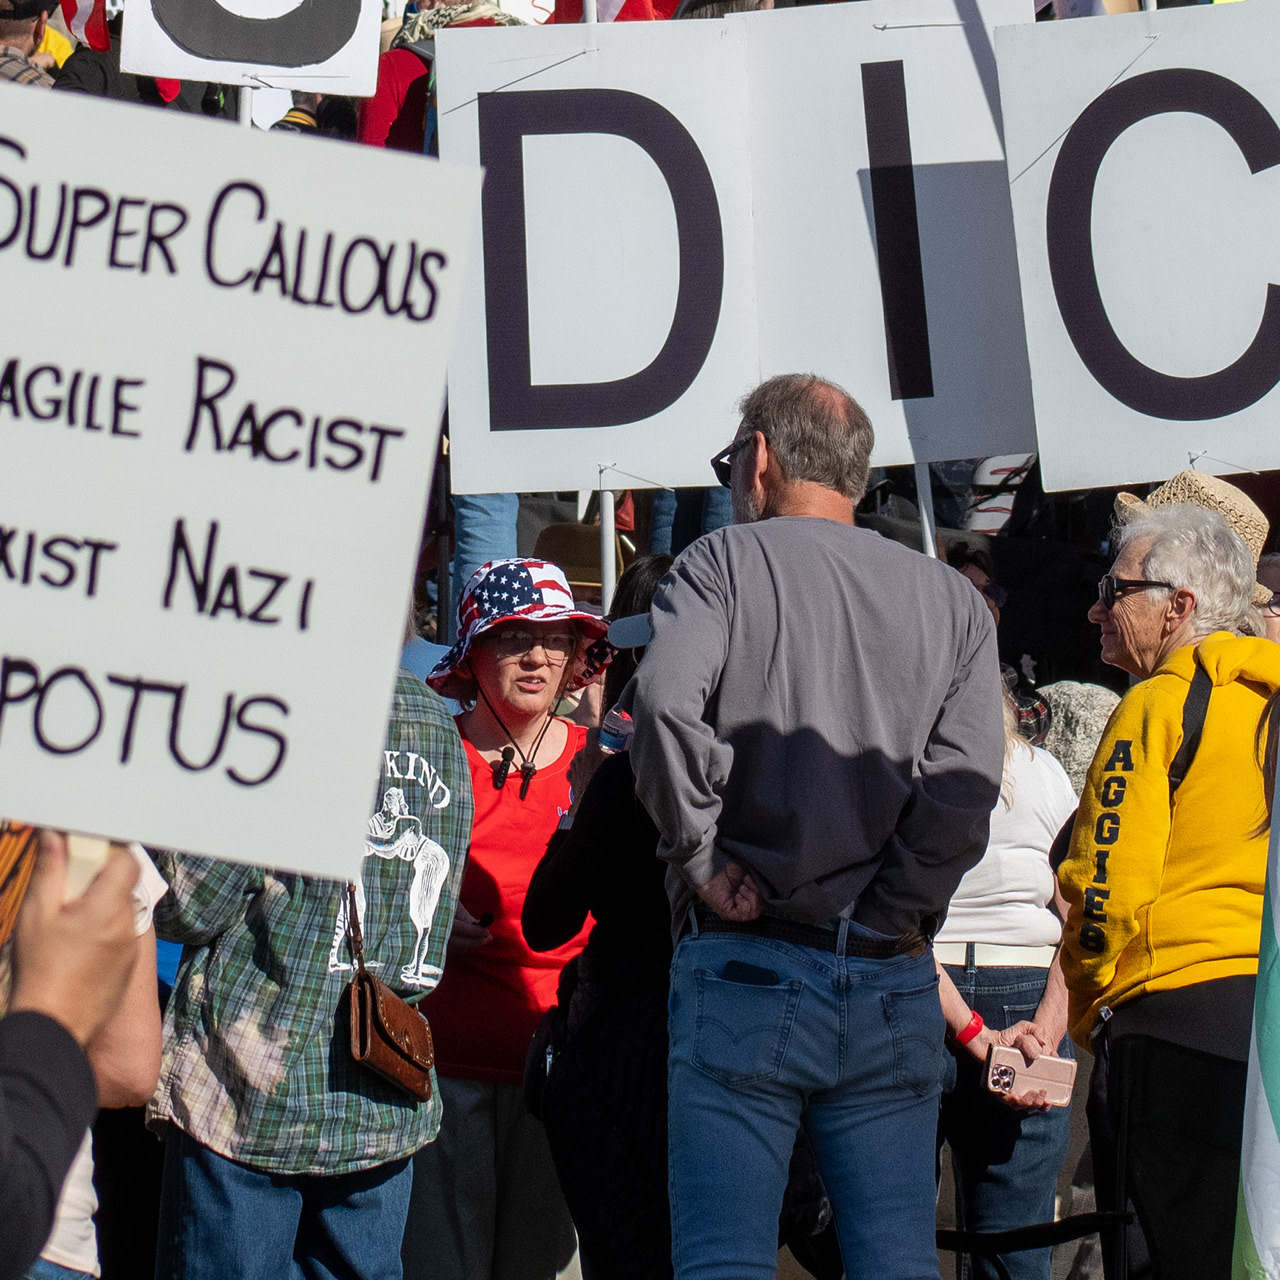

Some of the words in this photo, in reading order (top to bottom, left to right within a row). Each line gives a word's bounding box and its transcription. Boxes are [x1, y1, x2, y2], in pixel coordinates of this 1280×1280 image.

[204, 181, 448, 322] CALLOUS
[185, 356, 407, 485] RACIST
[162, 518, 314, 632] NAZI
[1077, 738, 1136, 956] AGGIES
